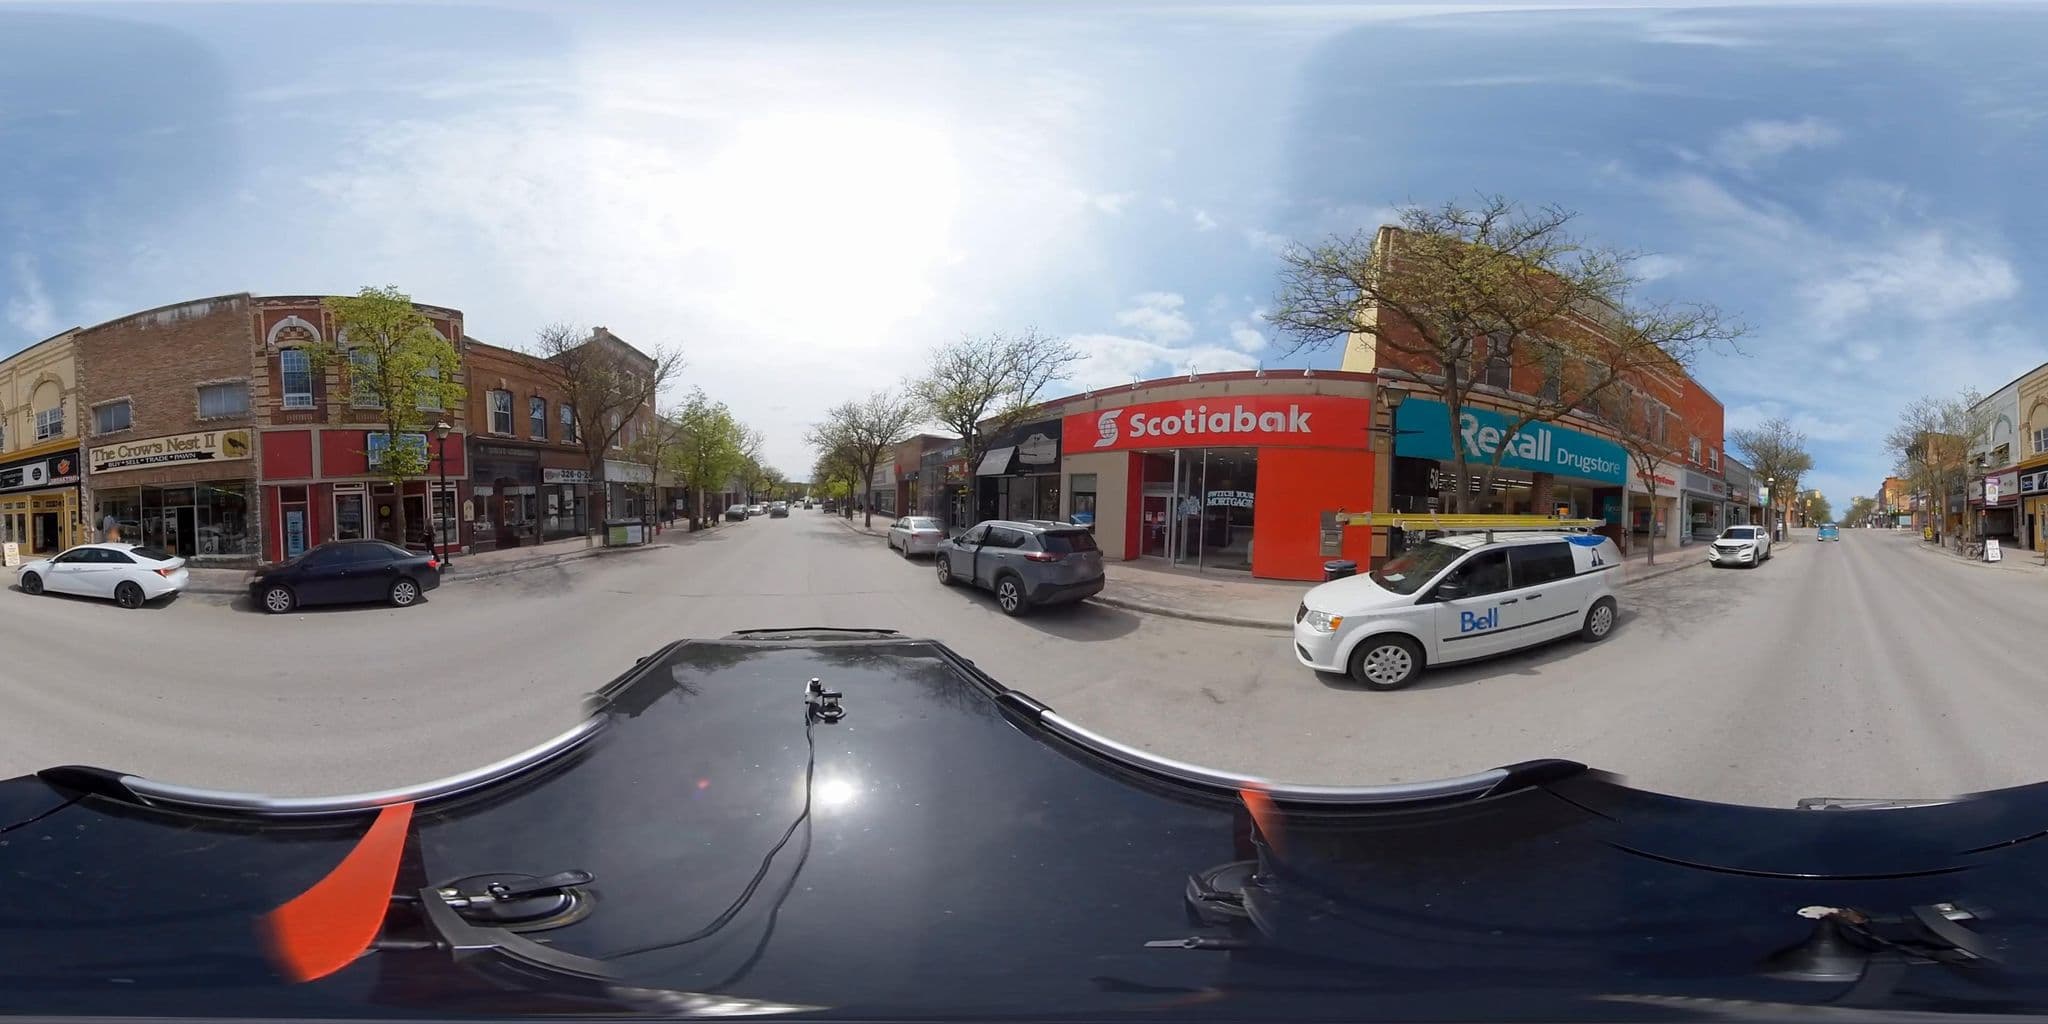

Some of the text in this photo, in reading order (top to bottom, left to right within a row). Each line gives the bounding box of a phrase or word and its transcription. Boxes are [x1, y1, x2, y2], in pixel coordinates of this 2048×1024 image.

[1129, 404, 1313, 438] Scotiabak
[92, 433, 216, 462] The Crow's Nest II
[1460, 413, 1621, 474] Rexall Drugstore
[146, 456, 169, 464] TRADE
[174, 453, 196, 461] PAWN
[1206, 498, 1254, 508] MORTGAGE
[1207, 490, 1255, 499] SWITCH YOUR
[1460, 607, 1499, 633] Bell
